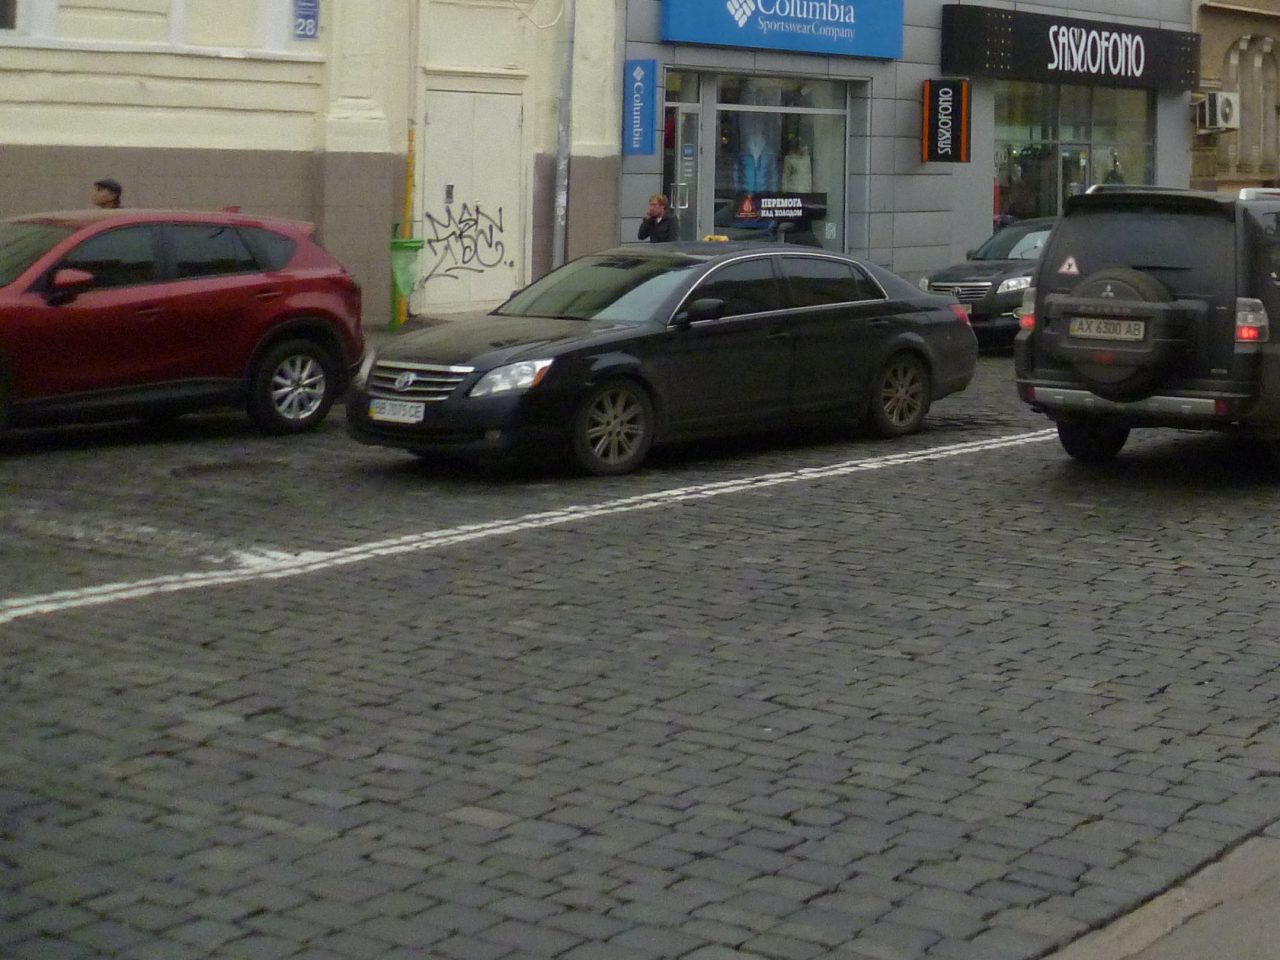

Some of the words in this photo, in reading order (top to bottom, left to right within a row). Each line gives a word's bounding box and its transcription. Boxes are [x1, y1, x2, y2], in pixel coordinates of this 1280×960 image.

[296, 18, 315, 36] 28
[632, 82, 645, 148] Columbia
[761, 198, 802, 208] ПЕРЕМОГА
[1079, 320, 1092, 333] AX
